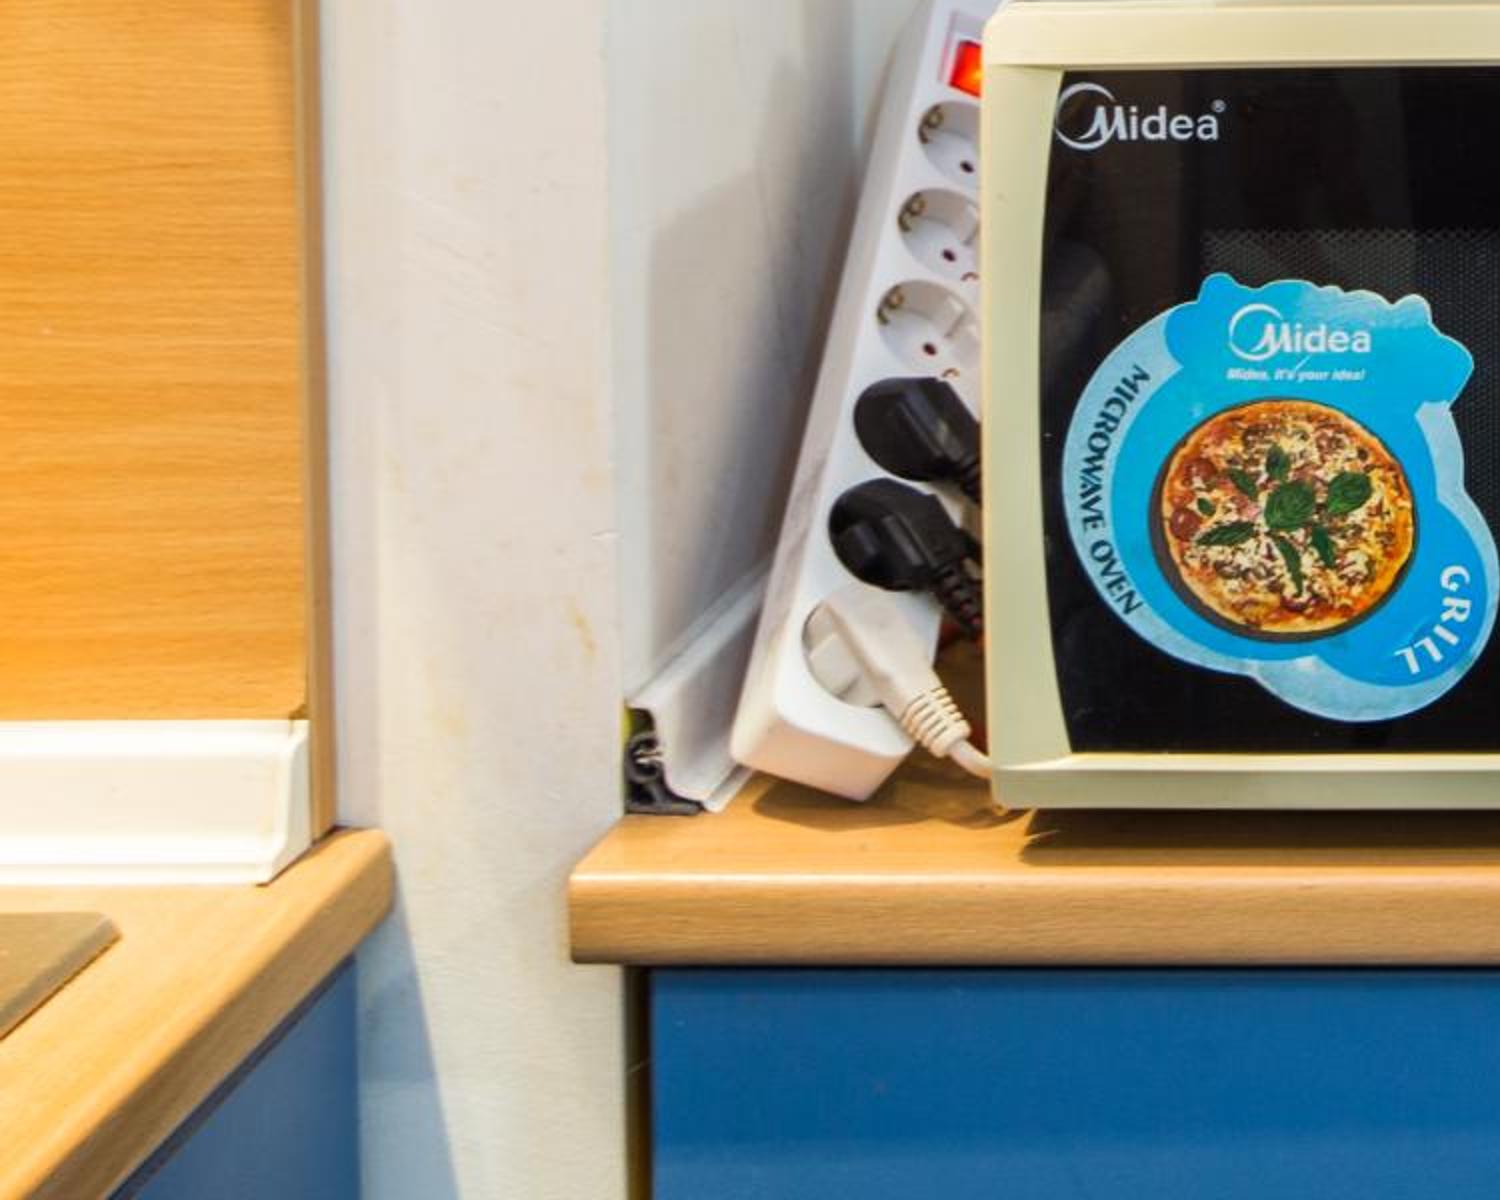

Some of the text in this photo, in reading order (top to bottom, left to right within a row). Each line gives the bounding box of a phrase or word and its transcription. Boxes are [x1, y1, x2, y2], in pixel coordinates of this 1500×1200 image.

[1055, 82, 1219, 150] Midea
[1229, 303, 1372, 362] Midea
[1079, 363, 1151, 616] MICROWAVE OVEN
[1393, 564, 1473, 676] GRILL
